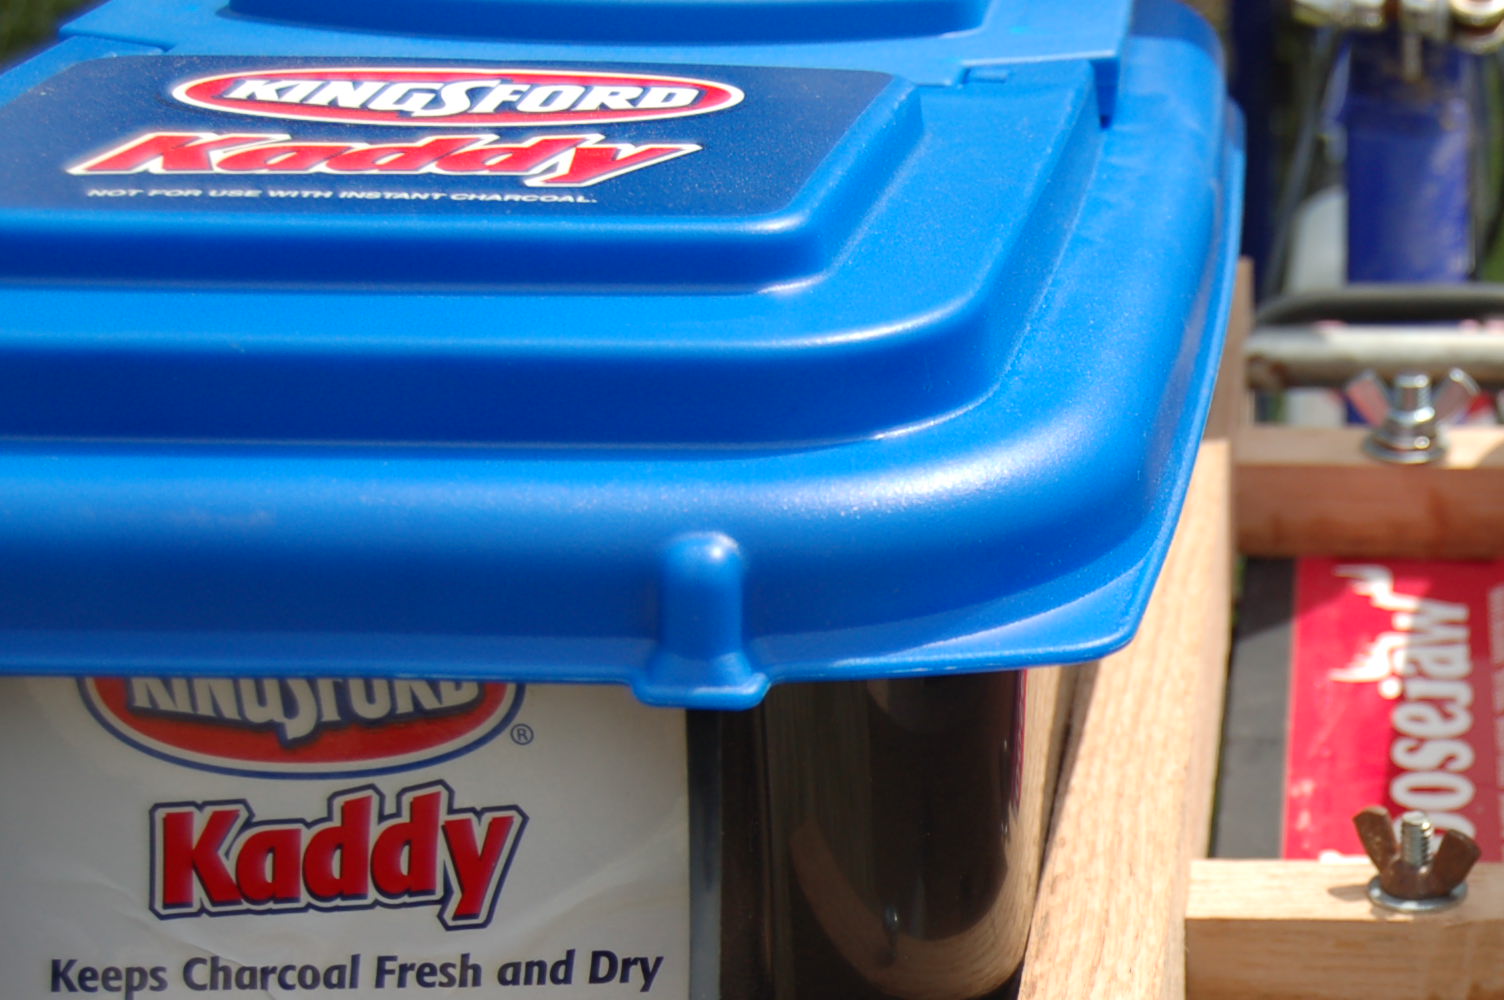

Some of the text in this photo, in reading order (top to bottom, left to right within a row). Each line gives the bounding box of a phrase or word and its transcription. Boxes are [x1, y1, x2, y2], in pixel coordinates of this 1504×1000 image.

[228, 79, 700, 118] KINGSFORD
[70, 133, 699, 187] Kaddy
[208, 188, 261, 196] USE
[267, 189, 333, 197] WITH
[338, 190, 447, 201] INSTANT
[150, 780, 528, 930] Kaddy
[50, 949, 663, 999] Keeps Charcoal Fresh and Dry
